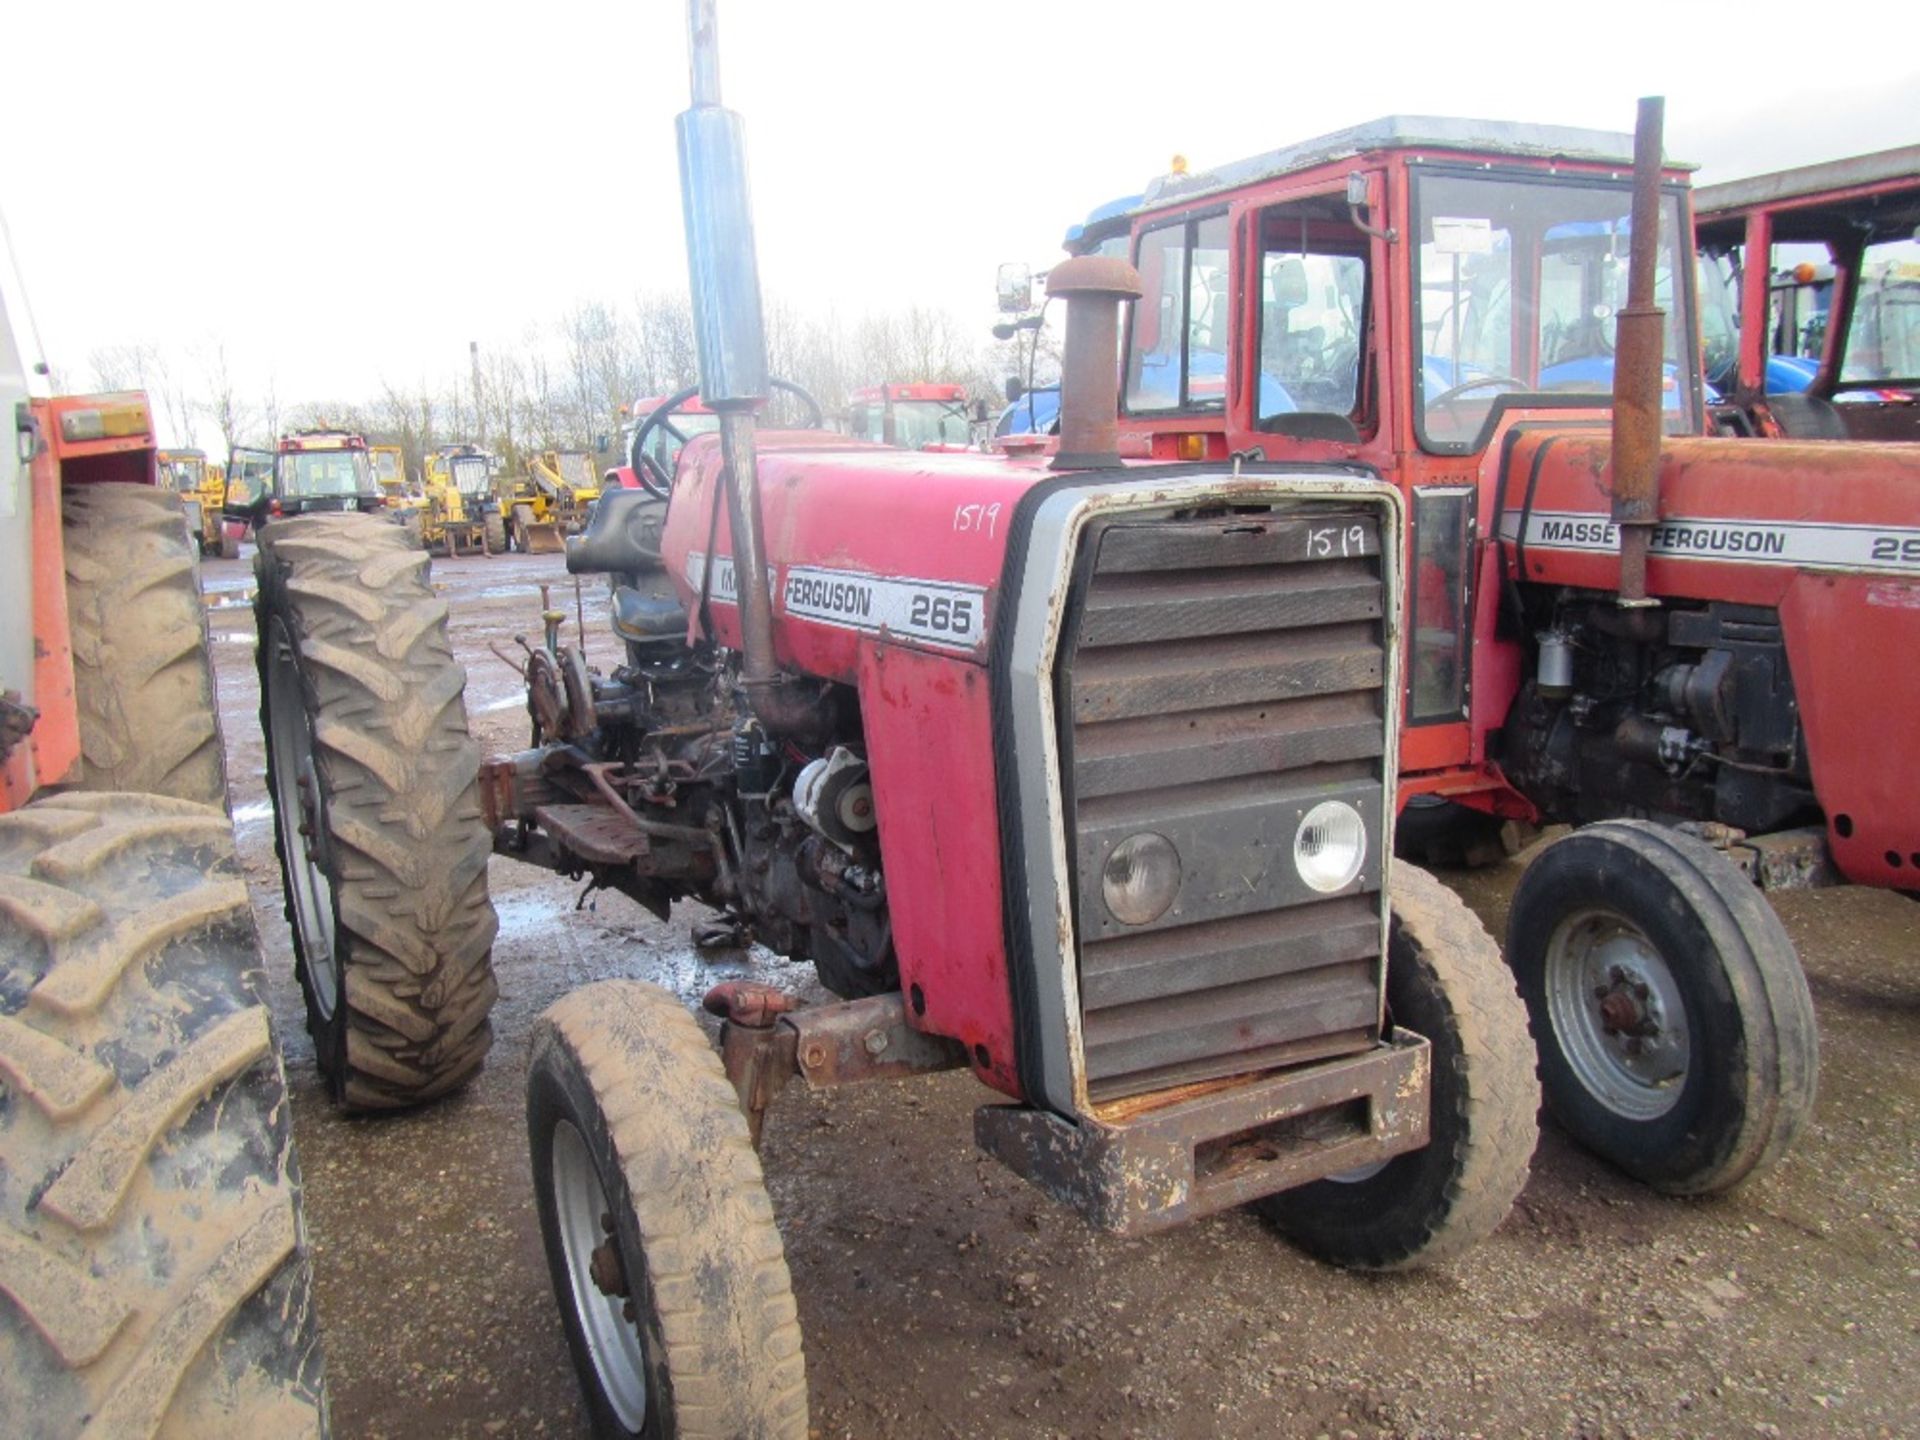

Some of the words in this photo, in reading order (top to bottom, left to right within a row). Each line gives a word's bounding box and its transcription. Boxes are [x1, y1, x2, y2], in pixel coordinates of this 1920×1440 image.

[953, 503, 1000, 538] 1519
[1541, 521, 1621, 544] MASSE
[1650, 527, 1785, 554] FERGUSON
[1307, 526, 1364, 557] 1519
[785, 577, 872, 617] FERGUSON
[909, 595, 972, 634] 265
